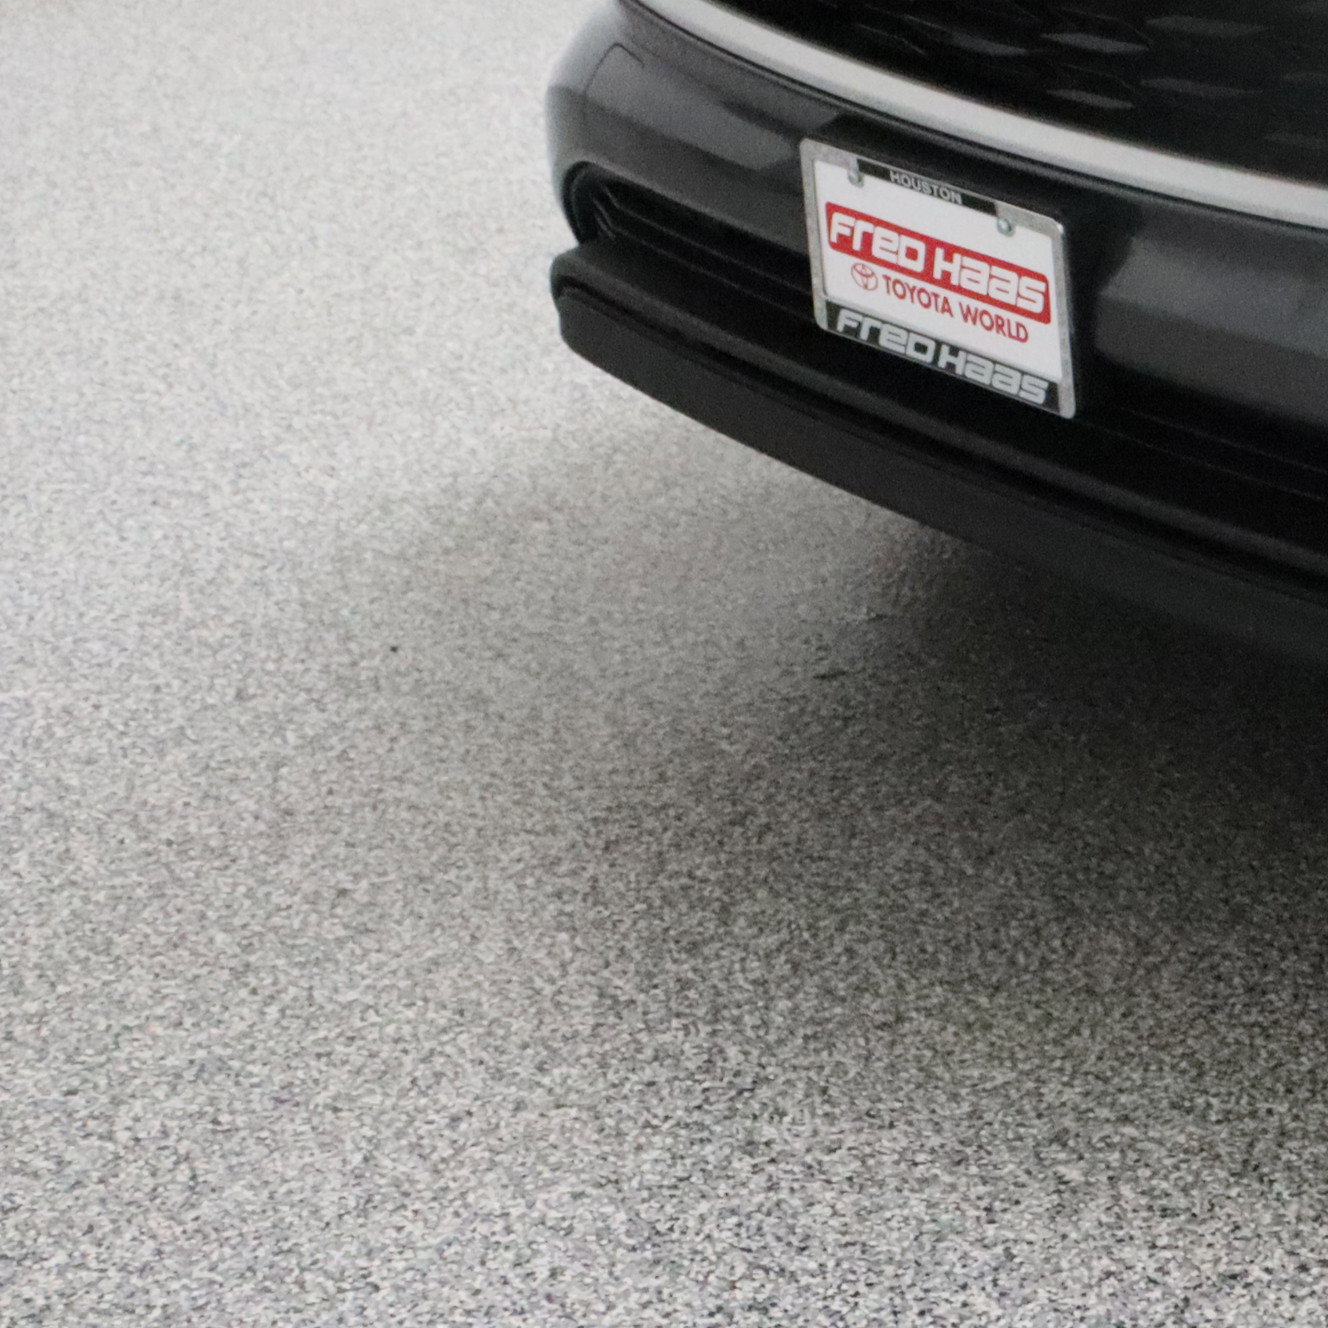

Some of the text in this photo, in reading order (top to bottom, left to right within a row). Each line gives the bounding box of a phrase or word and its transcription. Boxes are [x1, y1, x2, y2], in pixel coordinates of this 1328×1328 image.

[889, 170, 962, 205] HOUSTON
[882, 274, 1029, 344] TOYOTA WORLD
